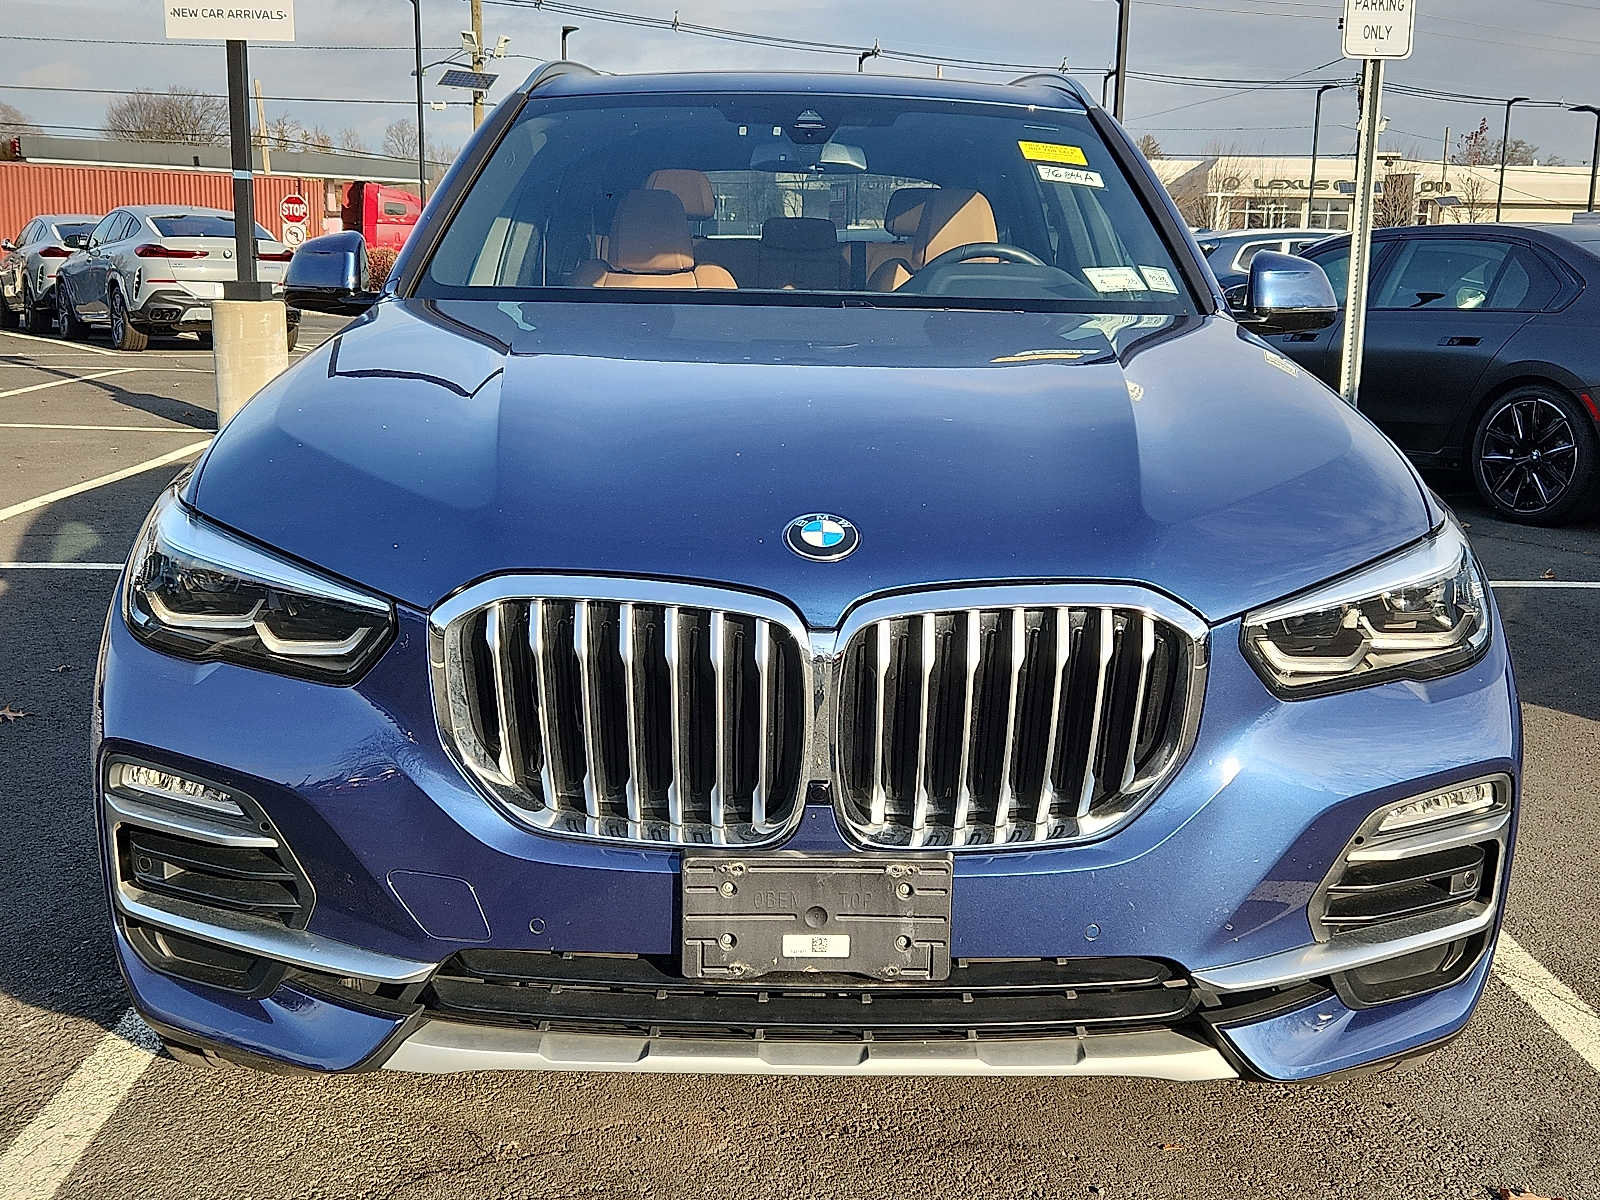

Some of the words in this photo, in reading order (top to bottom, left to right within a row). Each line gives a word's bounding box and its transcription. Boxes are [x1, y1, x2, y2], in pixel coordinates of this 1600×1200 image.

[1355, 0, 1405, 12] PARKING
[173, 7, 198, 18] NEW
[201, 8, 225, 19] CAR
[227, 9, 284, 20] ARRIVALS
[1363, 24, 1393, 40] ONLY
[1253, 179, 1330, 190] LEXUS
[282, 203, 307, 217] STOP
[753, 889, 799, 910] OBEN
[838, 891, 873, 911] TOP
